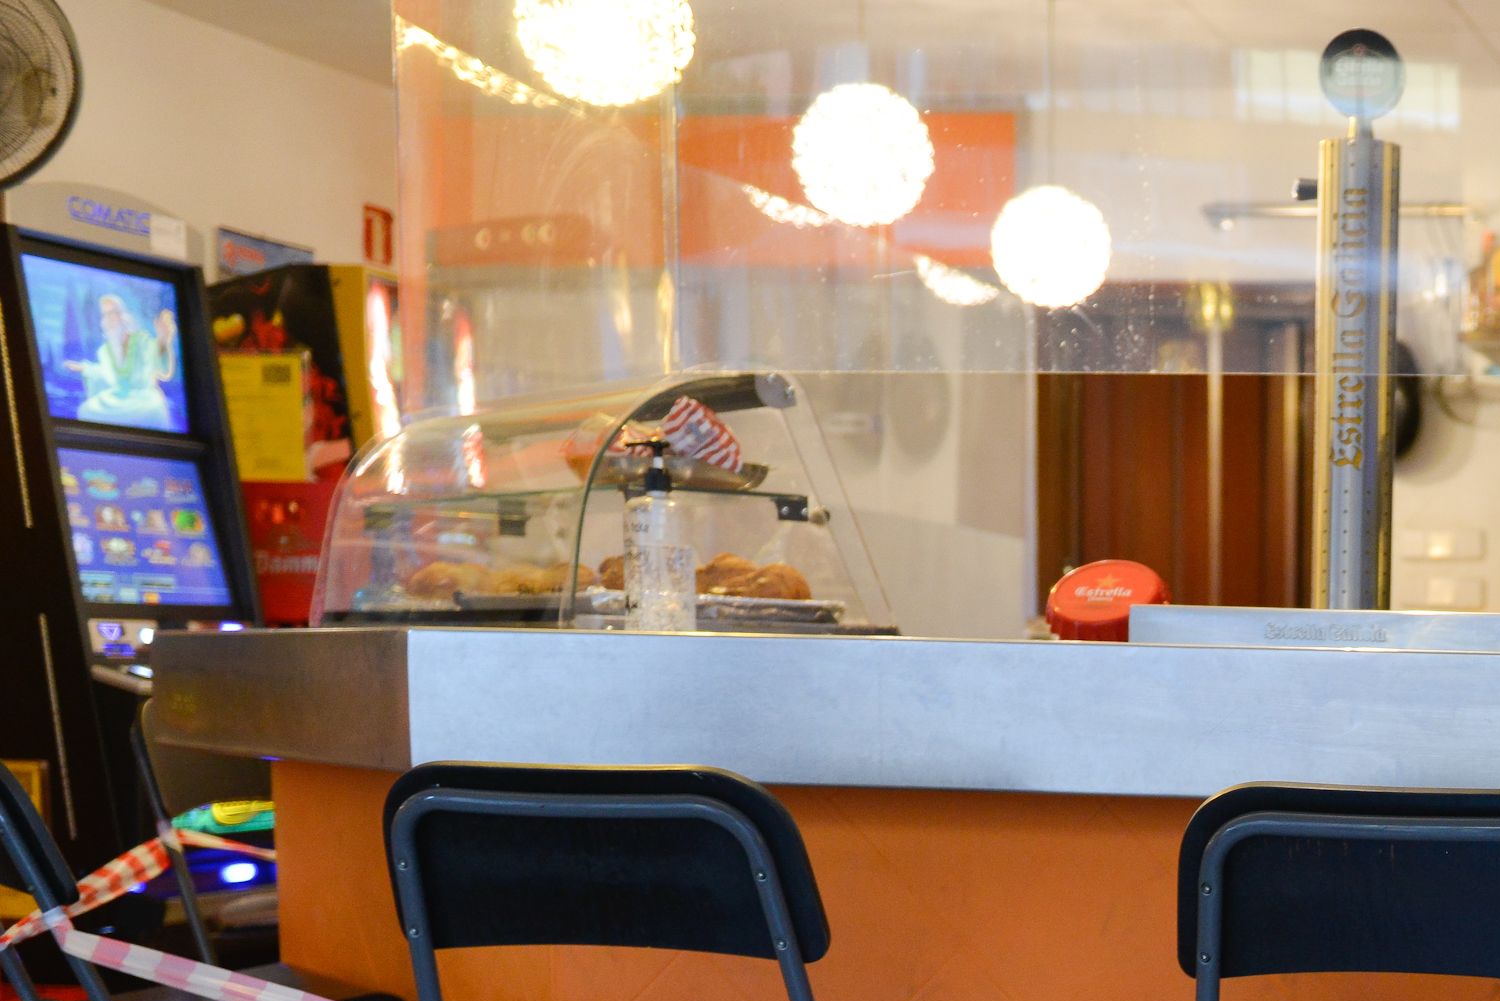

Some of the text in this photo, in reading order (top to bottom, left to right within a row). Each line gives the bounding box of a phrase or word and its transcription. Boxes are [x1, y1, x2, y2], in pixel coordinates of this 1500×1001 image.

[1329, 186, 1368, 469] Estrella Galicia
[1074, 585, 1134, 599] Estrella
